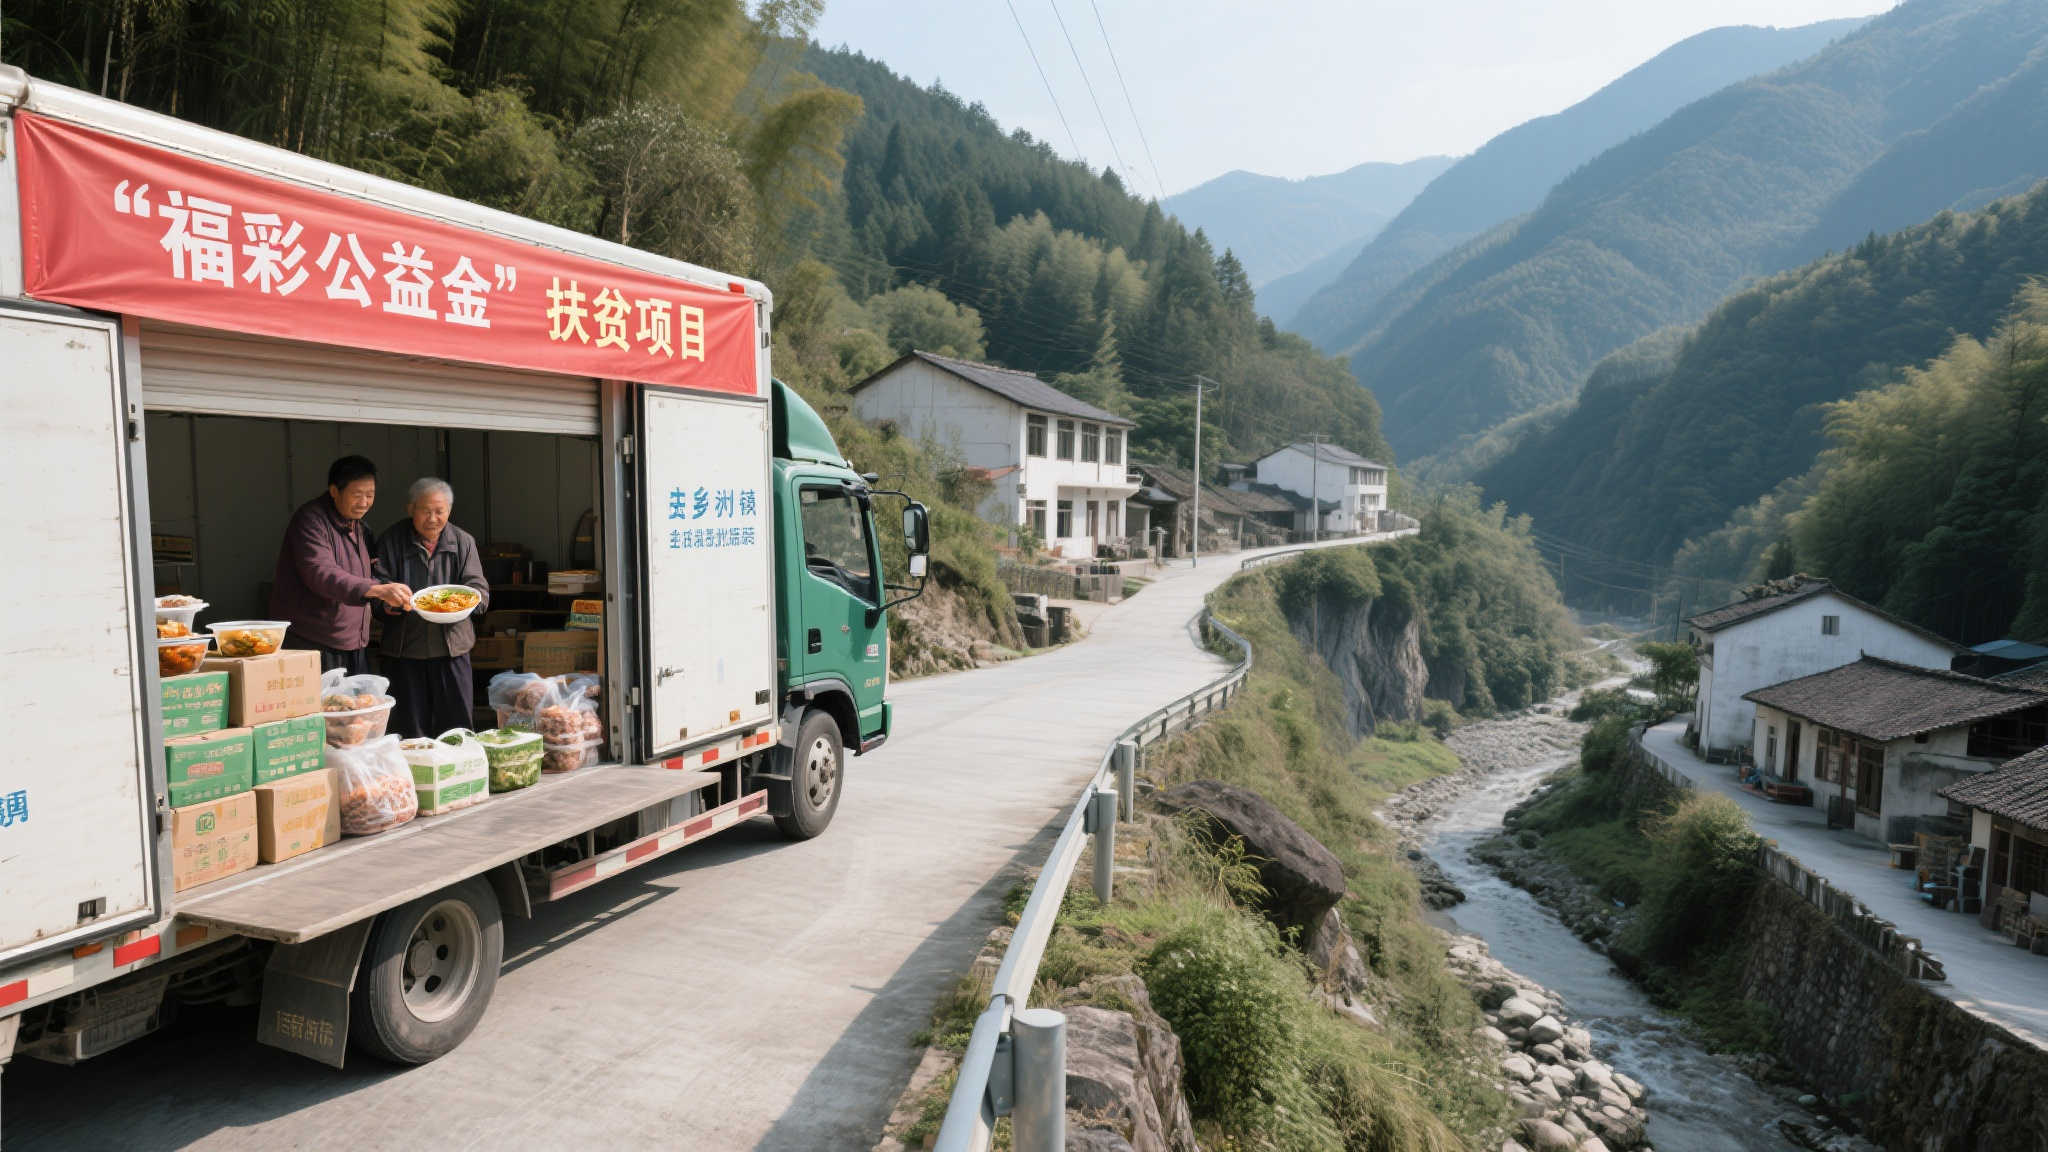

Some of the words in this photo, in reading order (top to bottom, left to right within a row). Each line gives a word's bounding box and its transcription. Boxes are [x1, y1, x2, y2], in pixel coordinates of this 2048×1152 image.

[114, 180, 517, 328] “福彩公益金”
[546, 278, 705, 362] 扶贫项目
